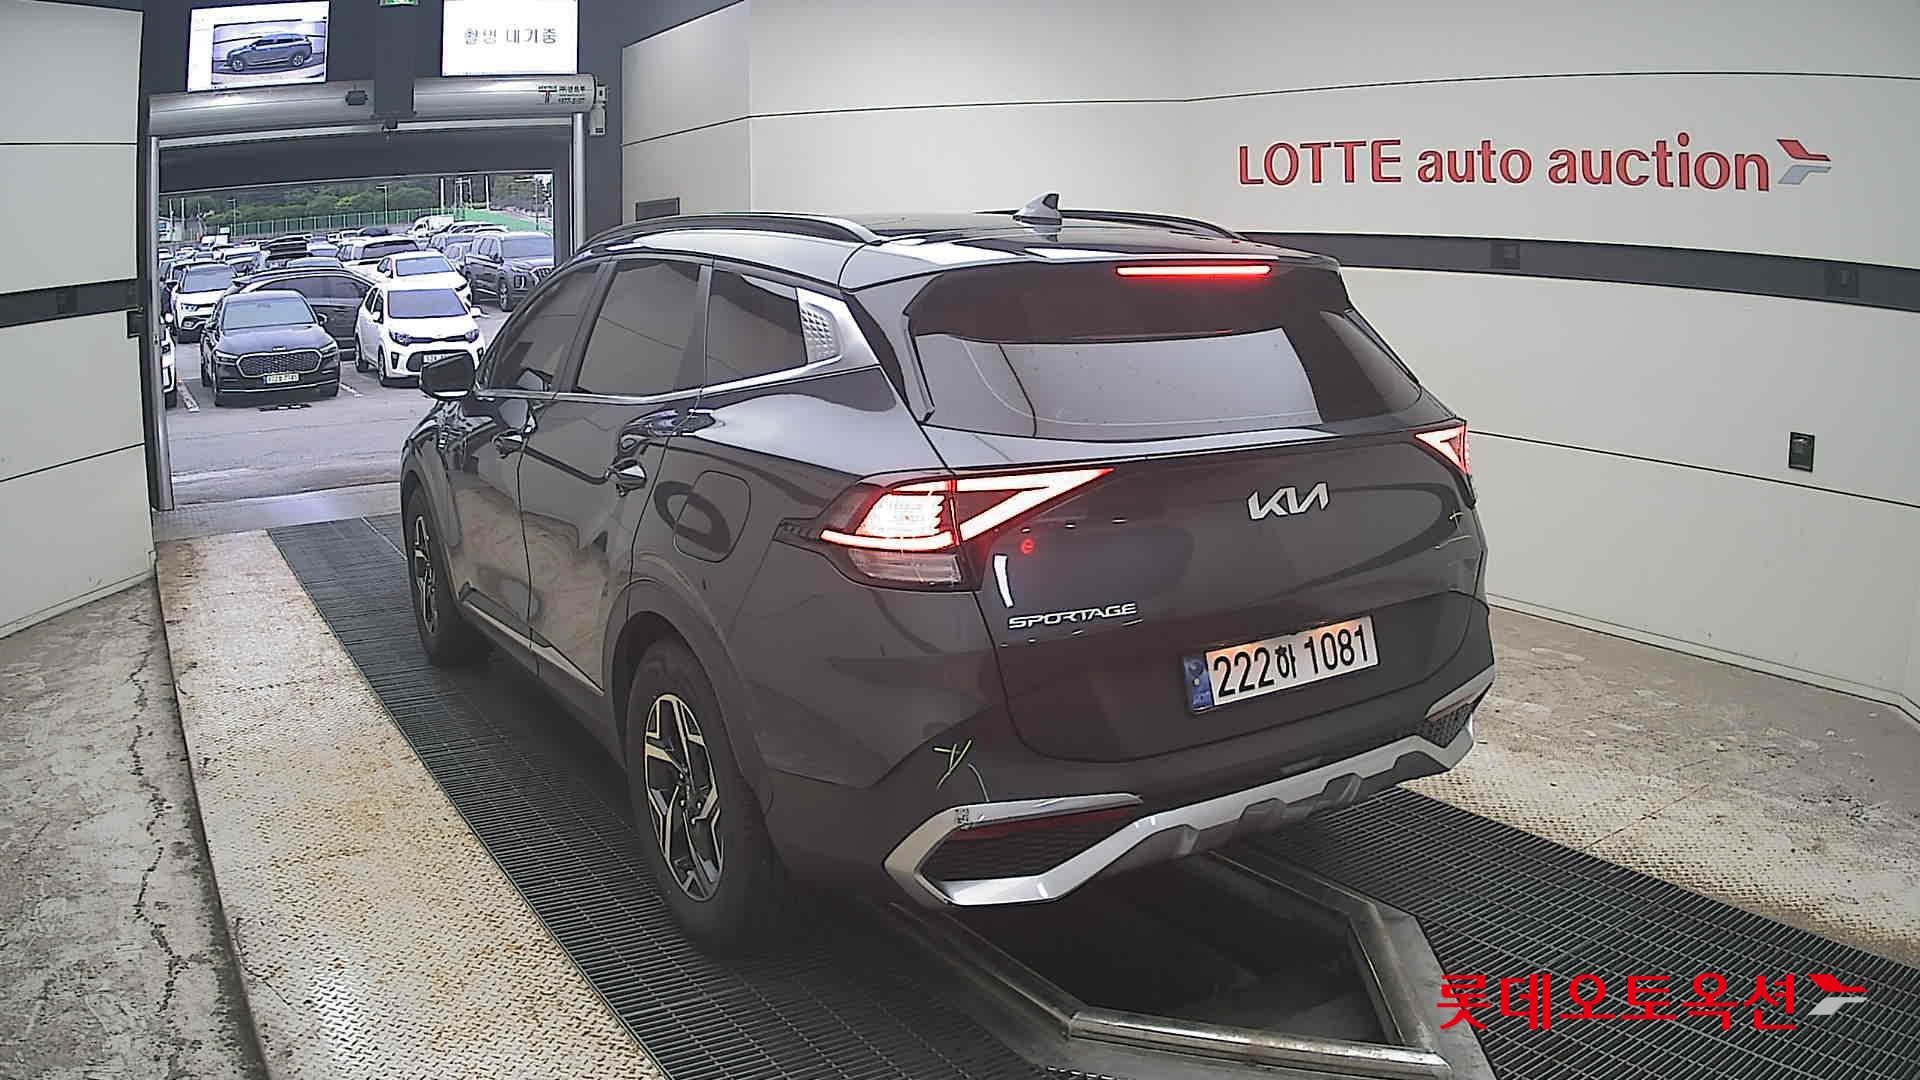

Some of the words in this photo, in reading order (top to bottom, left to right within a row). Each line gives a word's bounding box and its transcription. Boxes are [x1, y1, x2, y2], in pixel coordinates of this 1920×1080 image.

[1239, 139, 1401, 186] LOTTE
[1417, 140, 1532, 184] auto
[1548, 132, 1769, 192] auction
[1008, 602, 1137, 629] SPORTAGE
[1213, 643, 1297, 698] 222하
[1304, 624, 1368, 674] 1081
